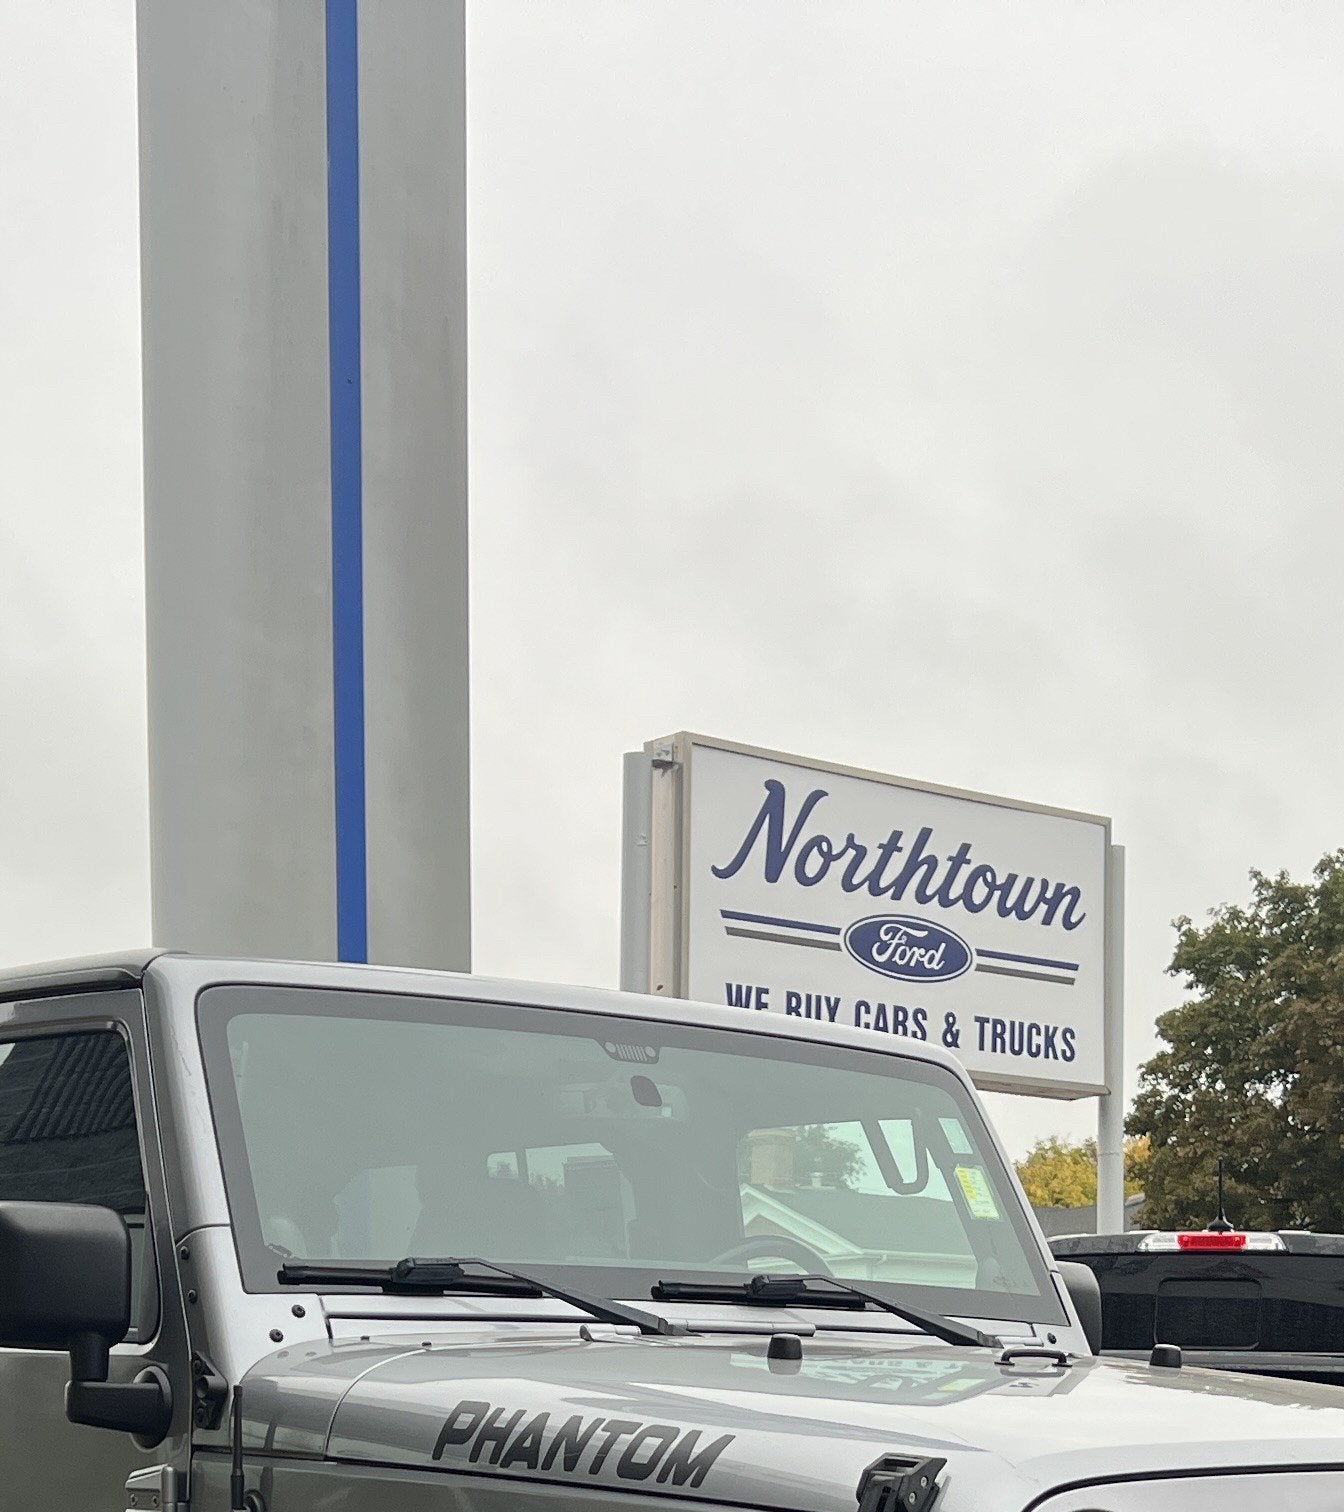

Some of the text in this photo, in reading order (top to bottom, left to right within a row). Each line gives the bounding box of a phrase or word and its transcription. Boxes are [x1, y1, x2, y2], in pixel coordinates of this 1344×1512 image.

[710, 779, 1086, 931] Northtown
[870, 923, 947, 972] Ford
[725, 983, 769, 1011] WE
[855, 1000, 928, 1042] CARS
[942, 1012, 960, 1049] &
[975, 1015, 1076, 1063] TRUCKS
[431, 1400, 737, 1489] PHANTOM
